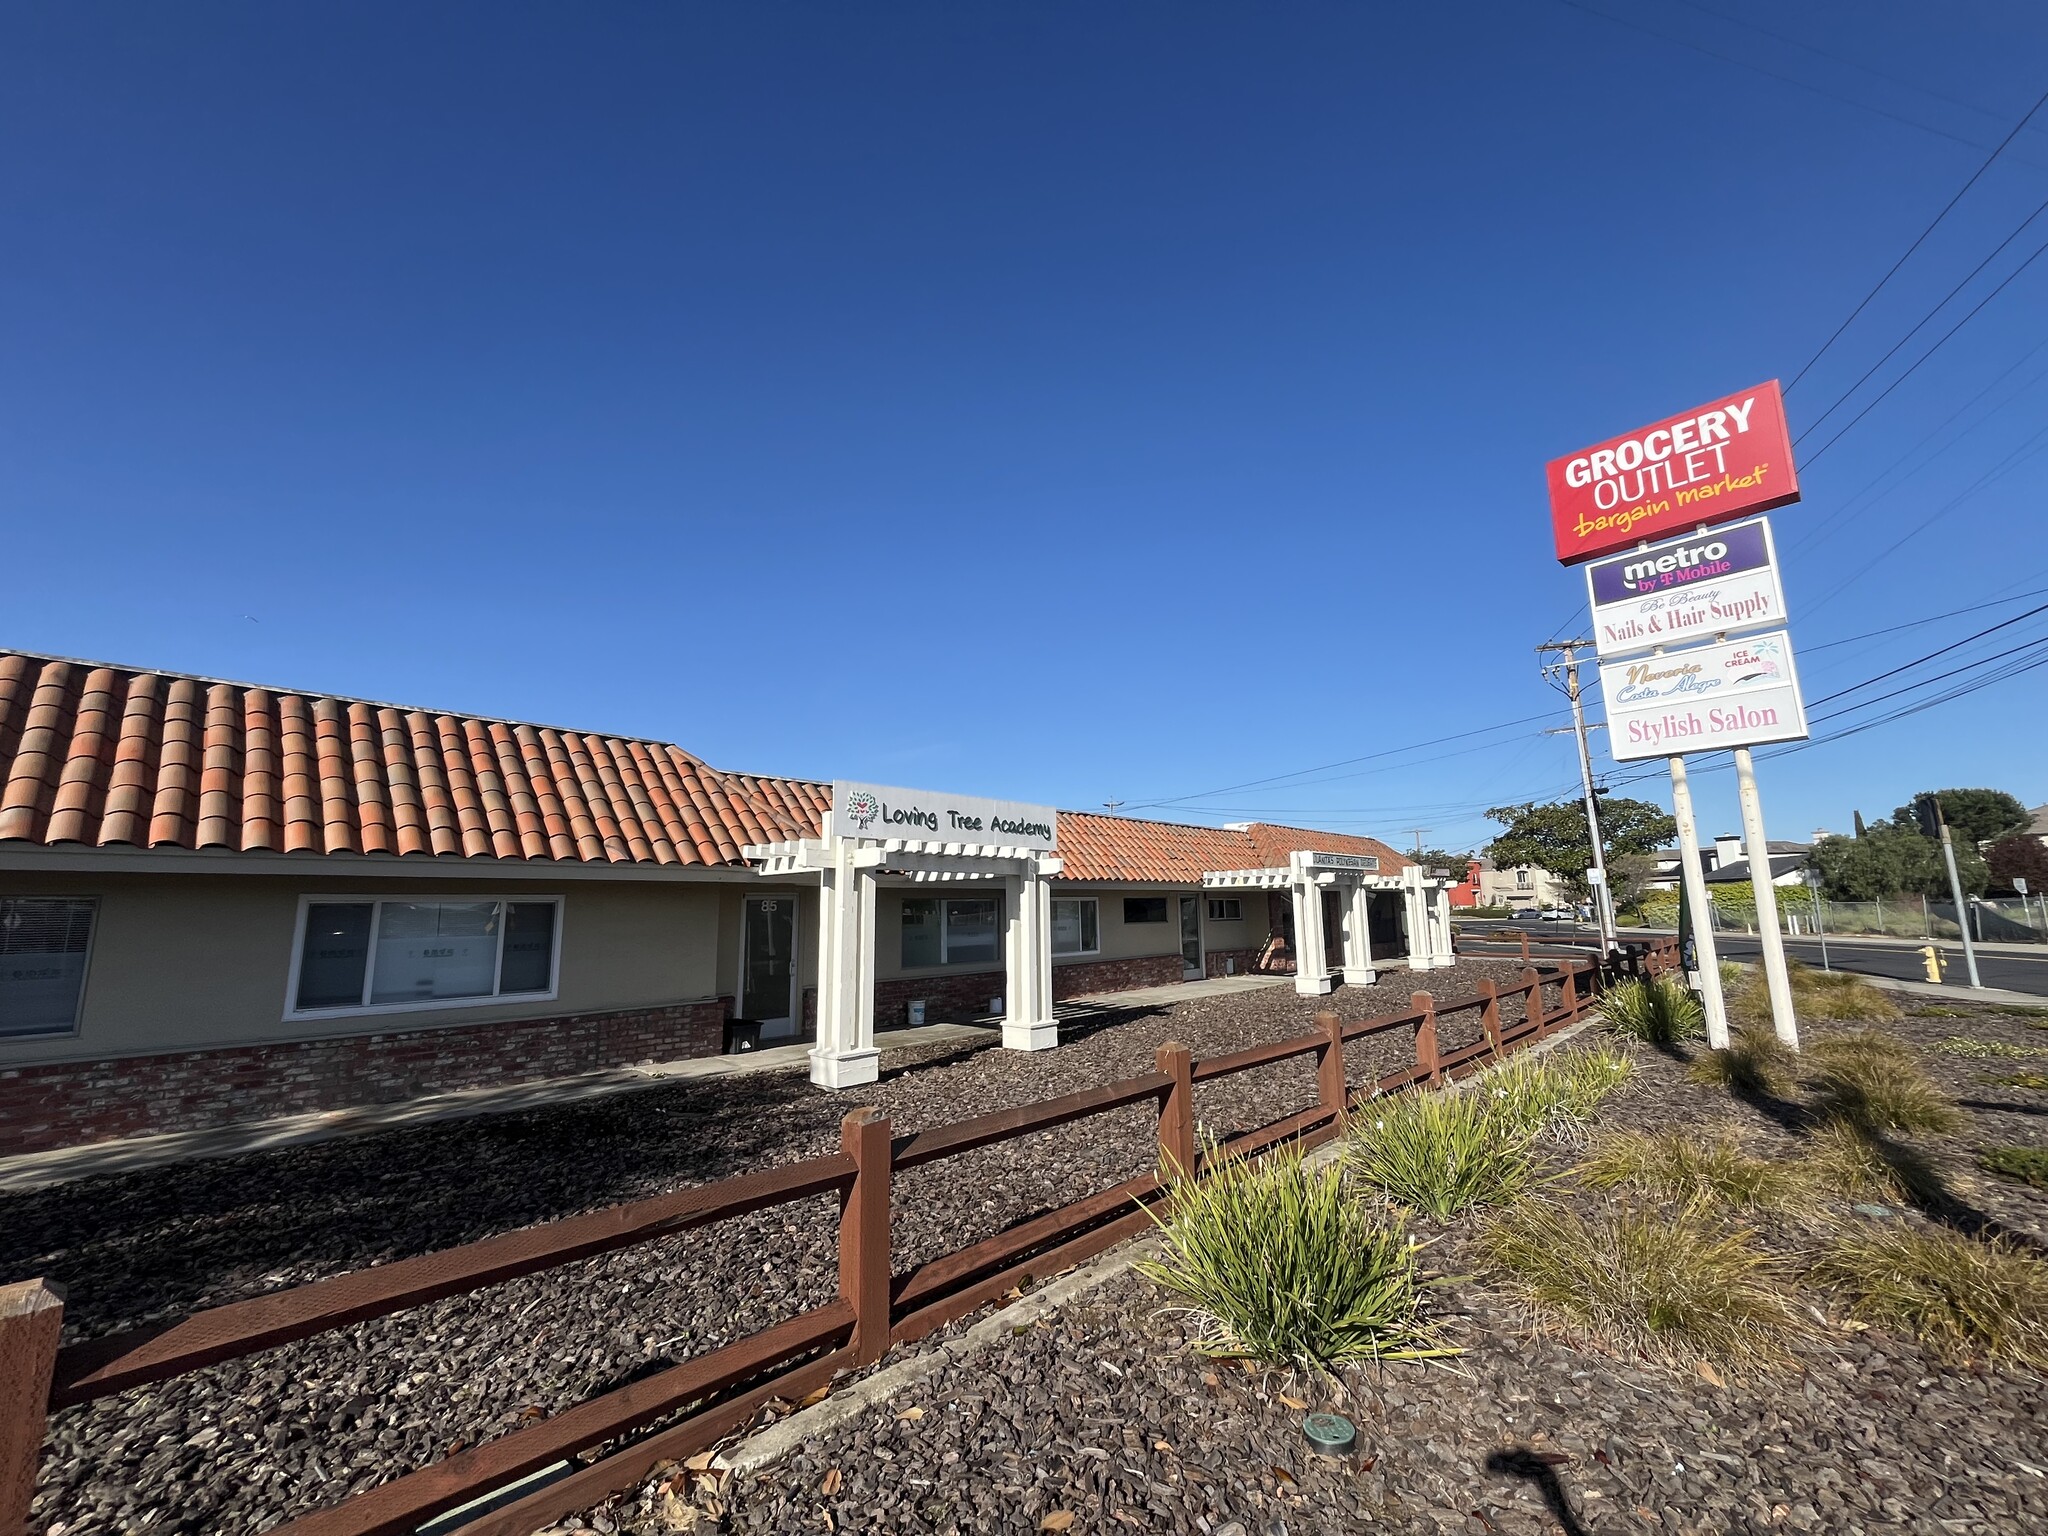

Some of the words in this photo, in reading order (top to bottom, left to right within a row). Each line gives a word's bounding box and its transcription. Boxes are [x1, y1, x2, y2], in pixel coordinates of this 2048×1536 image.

[1565, 397, 1755, 488] GROCERY
[1594, 440, 1730, 510] OUTLET
[1573, 500, 1670, 537] bargain
[1675, 464, 1769, 507] market
[1624, 542, 1728, 583] metro
[1638, 578, 1657, 593] by
[1676, 560, 1731, 584] Mobile
[1604, 619, 1644, 644] Nails
[1648, 613, 1662, 634] &
[1666, 605, 1706, 630] Hair
[1710, 591, 1770, 620] Supply
[1640, 597, 1666, 614] Be
[1669, 589, 1721, 607] Beauty
[1724, 655, 1761, 669] CREAM
[1732, 650, 1749, 660] ICE
[1616, 684, 1660, 704] Costa
[1661, 673, 1722, 694] Alegre
[1626, 663, 1703, 685] Neveria
[1628, 713, 1703, 746] Stylish
[1709, 705, 1778, 734] Salon
[882, 802, 938, 832] Loving
[946, 809, 983, 832] Tree
[990, 815, 1052, 842] Academy
[760, 900, 778, 912] 85
